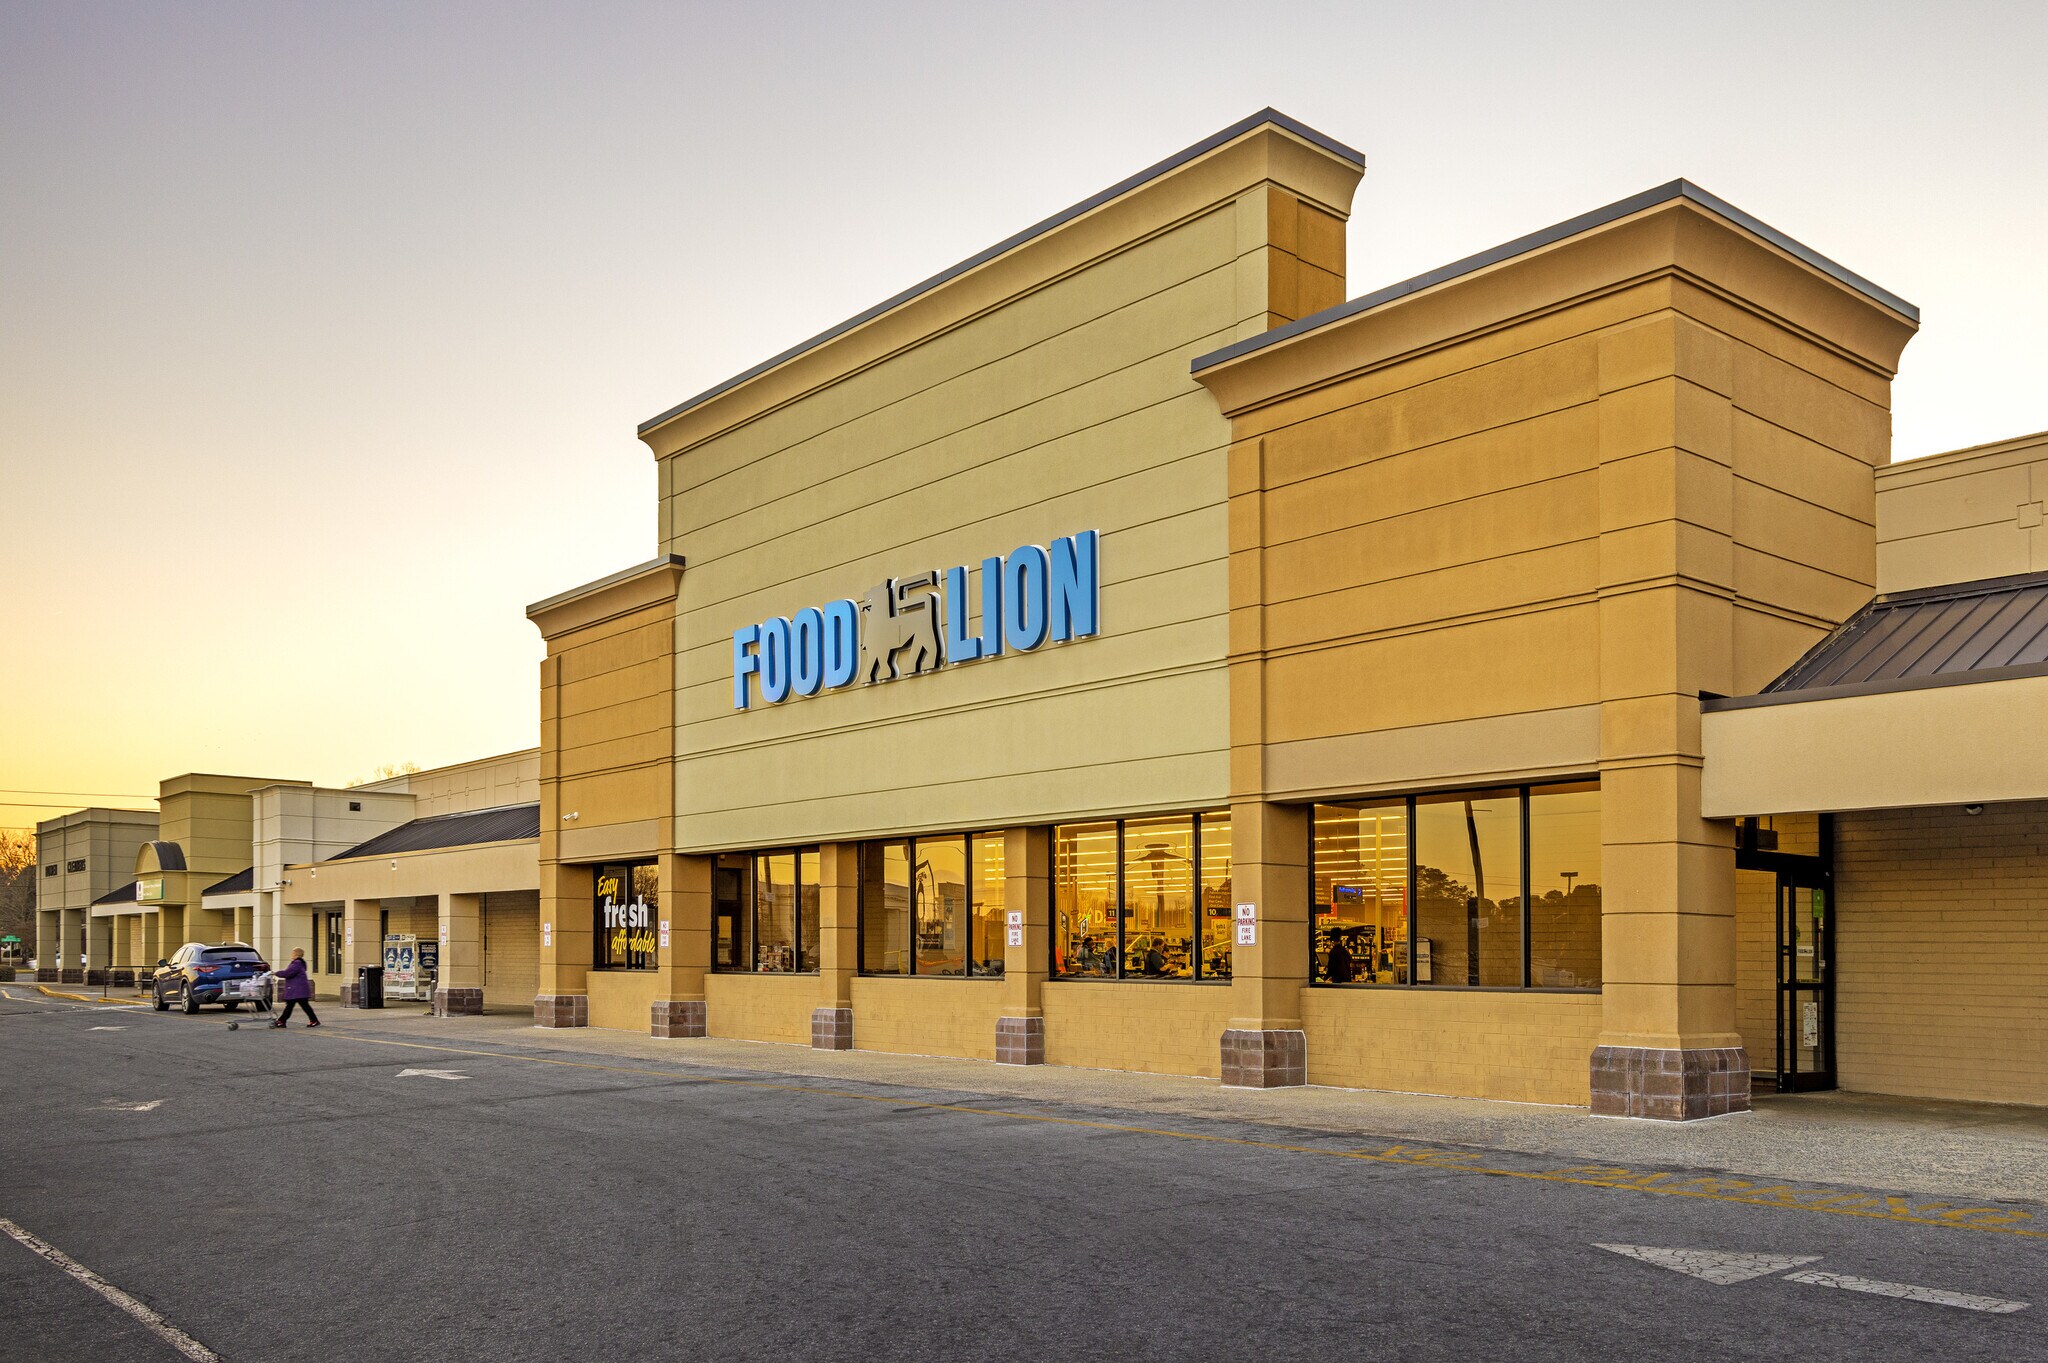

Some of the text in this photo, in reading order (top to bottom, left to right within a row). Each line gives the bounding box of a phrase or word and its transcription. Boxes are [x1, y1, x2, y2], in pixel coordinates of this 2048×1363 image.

[733, 529, 1100, 710] FOOD LION
[597, 876, 618, 904] Easy
[604, 895, 648, 928] fresh
[1237, 918, 1255, 926] PARKING
[1242, 907, 1250, 916] NO
[611, 929, 655, 954] affordable
[1543, 1165, 2033, 1224] PARKING
